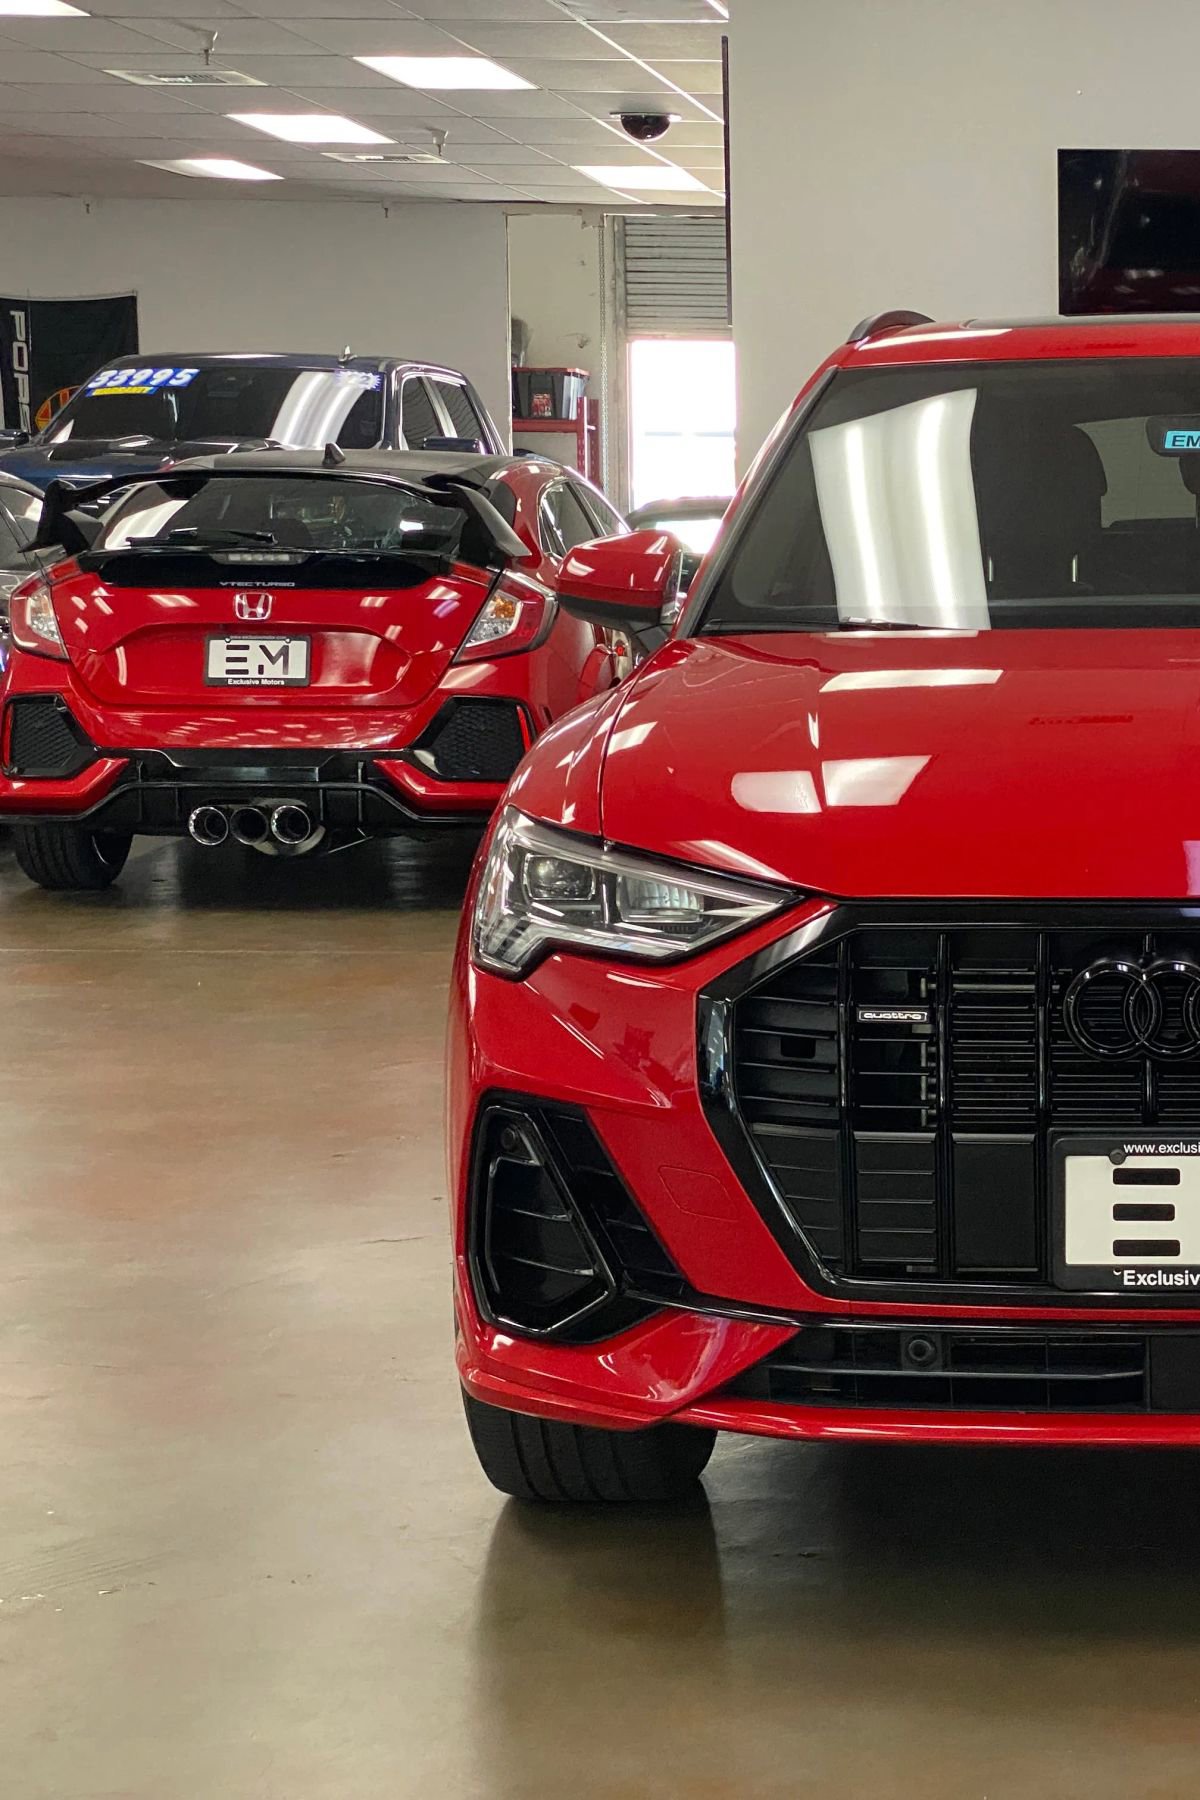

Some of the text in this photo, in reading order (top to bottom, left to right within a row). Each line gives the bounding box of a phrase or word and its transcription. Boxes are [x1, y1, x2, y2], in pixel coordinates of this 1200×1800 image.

[88, 369, 199, 388] 33995
[225, 645, 290, 675] EM
[863, 1012, 922, 1020] quattro
